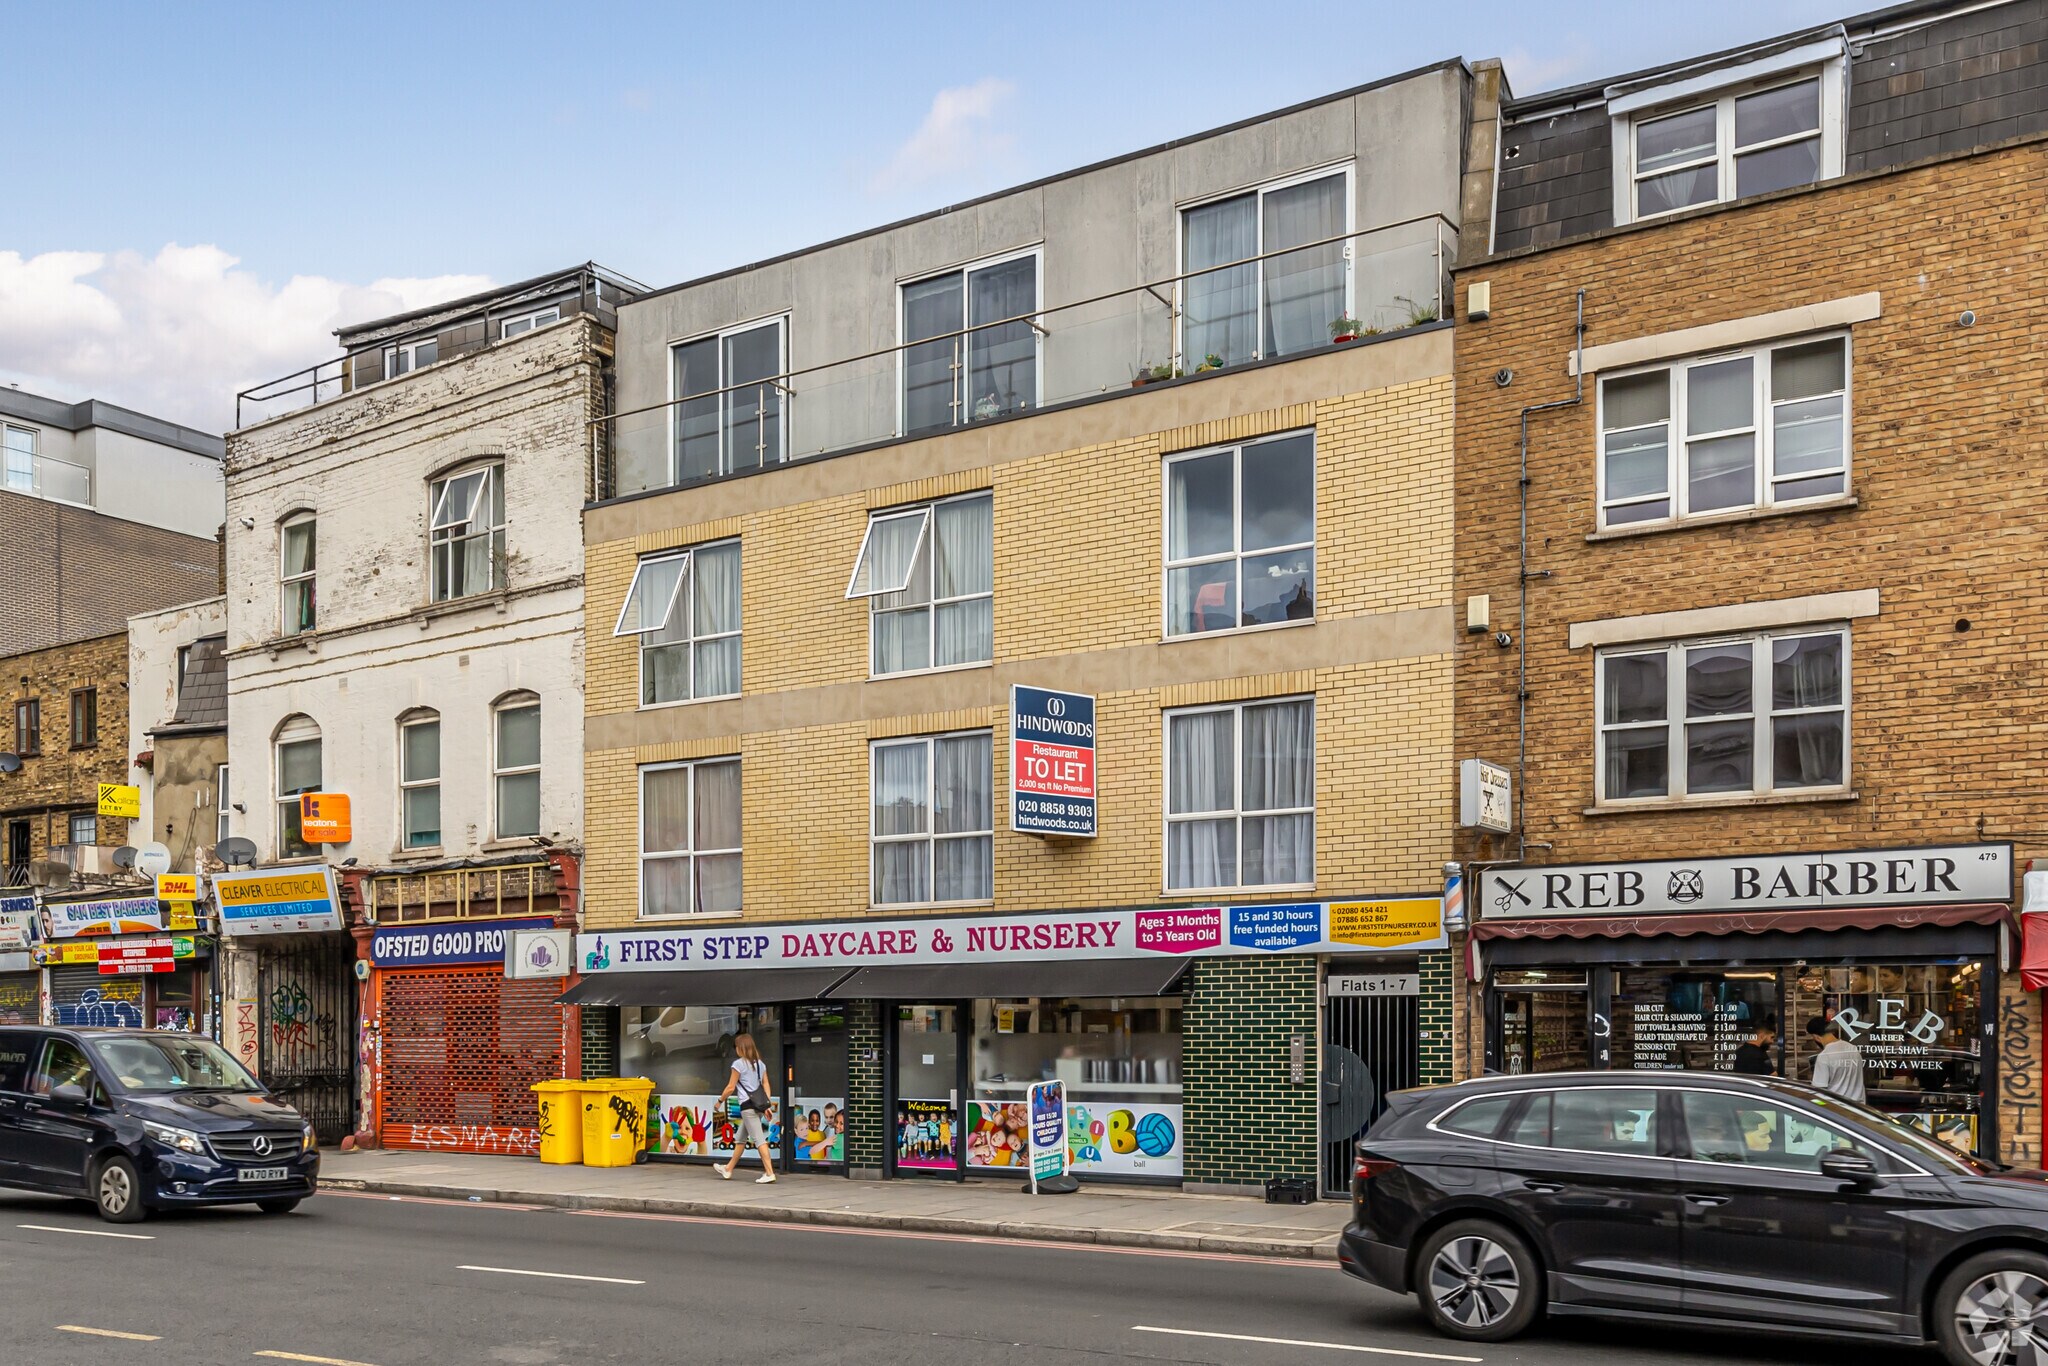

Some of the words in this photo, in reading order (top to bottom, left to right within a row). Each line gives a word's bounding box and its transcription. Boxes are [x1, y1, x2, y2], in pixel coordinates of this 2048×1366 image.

[1017, 714, 1093, 738] HINDWOODS
[1033, 744, 1078, 759] Restaurant
[1024, 757, 1049, 778] TO
[1054, 760, 1086, 782] LET
[1018, 779, 1036, 789] 2,000
[1037, 783, 1046, 791] sq
[1046, 782, 1052, 790] ft
[1053, 783, 1062, 791] No
[1063, 784, 1092, 794] Premium
[1018, 799, 1038, 812] 020
[1040, 801, 1065, 815] 8858
[1068, 804, 1092, 817] 9303
[303, 818, 337, 827] keatons
[1018, 814, 1092, 830] hindwoods.co.uk
[1978, 852, 1997, 861] 479
[164, 882, 190, 893] DHL
[221, 885, 264, 900] CLEAVER
[264, 880, 325, 897] ELECTRICAL
[1542, 871, 1645, 910] REB
[1730, 857, 1962, 900] BARBER
[67, 903, 88, 921] SAM
[88, 901, 112, 919] BEST
[112, 899, 159, 918] BARBERS
[240, 905, 277, 916] SERVICES
[279, 903, 313, 913] LIMITED
[1238, 912, 1250, 922] 15
[1251, 911, 1270, 922] and
[1272, 911, 1284, 921] 30
[1285, 909, 1314, 921] hours
[1360, 906, 1373, 914] 454
[1138, 917, 1165, 929] Ages
[1167, 915, 1174, 927] 3
[1176, 912, 1220, 927] Months
[1337, 921, 1437, 931] WWW.FIRSTSTEPNURSERY.CO.UK
[1233, 924, 1251, 935] free
[1253, 923, 1286, 934] funded
[1287, 922, 1318, 933] hours
[1337, 929, 1421, 939] info@firststepnursery.co.uk
[619, 936, 693, 963] FIRST
[702, 936, 770, 960] STEP
[781, 930, 919, 958] DAYCARE
[930, 929, 954, 953] &
[966, 921, 1122, 954] NURSERY
[1142, 932, 1154, 943] to
[1156, 931, 1163, 942] 5
[1165, 930, 1194, 942] Years
[1196, 928, 1217, 941] Old
[1254, 935, 1297, 947] available
[374, 935, 430, 958] OFSTED
[432, 932, 472, 956] GOOD
[1341, 979, 1376, 992] Flats
[1380, 980, 1386, 992] 1
[1399, 979, 1407, 991] 7
[1634, 1004, 1650, 1012] HAIR
[1651, 1004, 1664, 1012] CUT
[1831, 999, 1945, 1044] REB
[1634, 1033, 1656, 1041] BEARD
[1656, 1033, 1698, 1042] TRIM/SHAPE
[1698, 1033, 1708, 1041] UP
[1869, 1033, 1905, 1042] BARBER
[1864, 1045, 1898, 1054] TOWEL
[1898, 1045, 1929, 1055] SHAVE
[1862, 1059, 1866, 1067] 7
[1868, 1059, 1897, 1068] DAYS
[1899, 1060, 1907, 1068] A
[1910, 1061, 1943, 1070] WEEK
[908, 1100, 947, 1112] Welcome
[1107, 1109, 1139, 1154] B
[1086, 1147, 1095, 1158] U
[1133, 1159, 1146, 1168] ball
